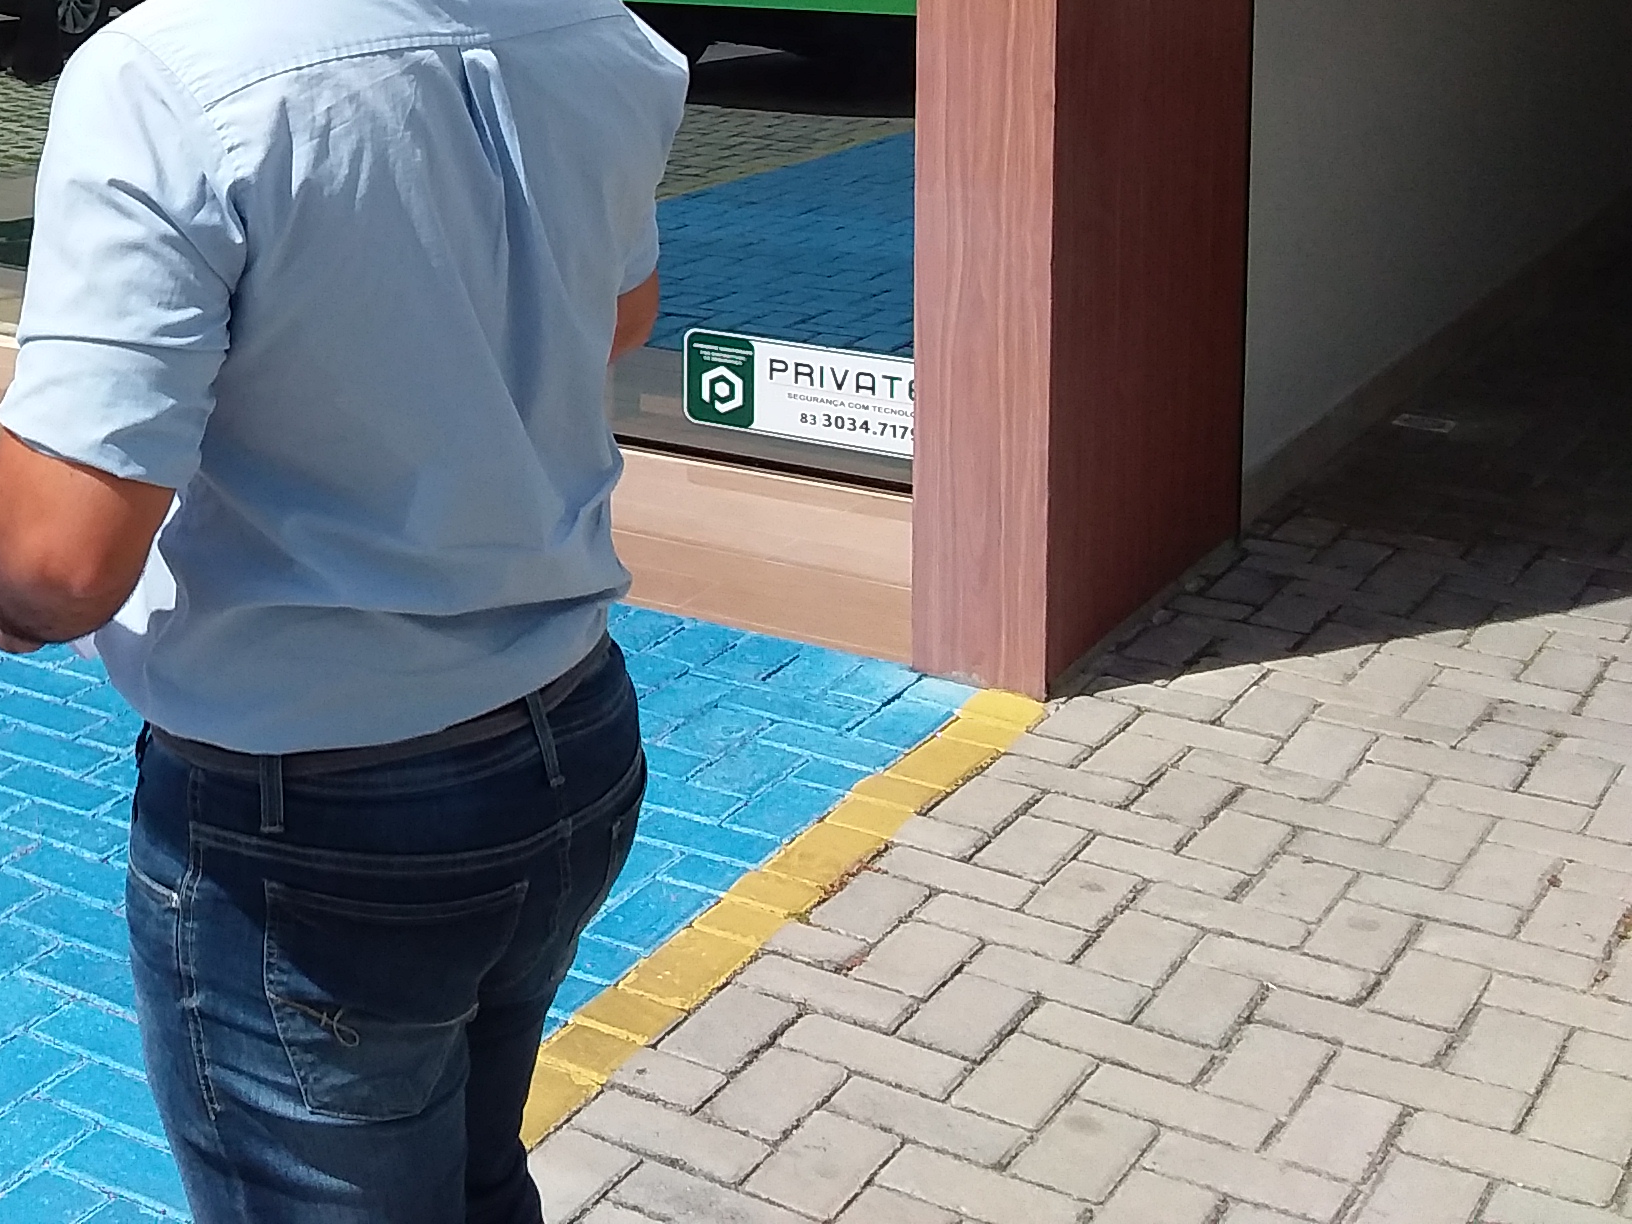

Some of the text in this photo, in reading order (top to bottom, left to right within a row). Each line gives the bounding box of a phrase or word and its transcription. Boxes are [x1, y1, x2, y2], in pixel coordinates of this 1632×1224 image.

[787, 392, 846, 409] SEGURANÇA
[847, 401, 870, 411] COM
[799, 412, 817, 426] 83
